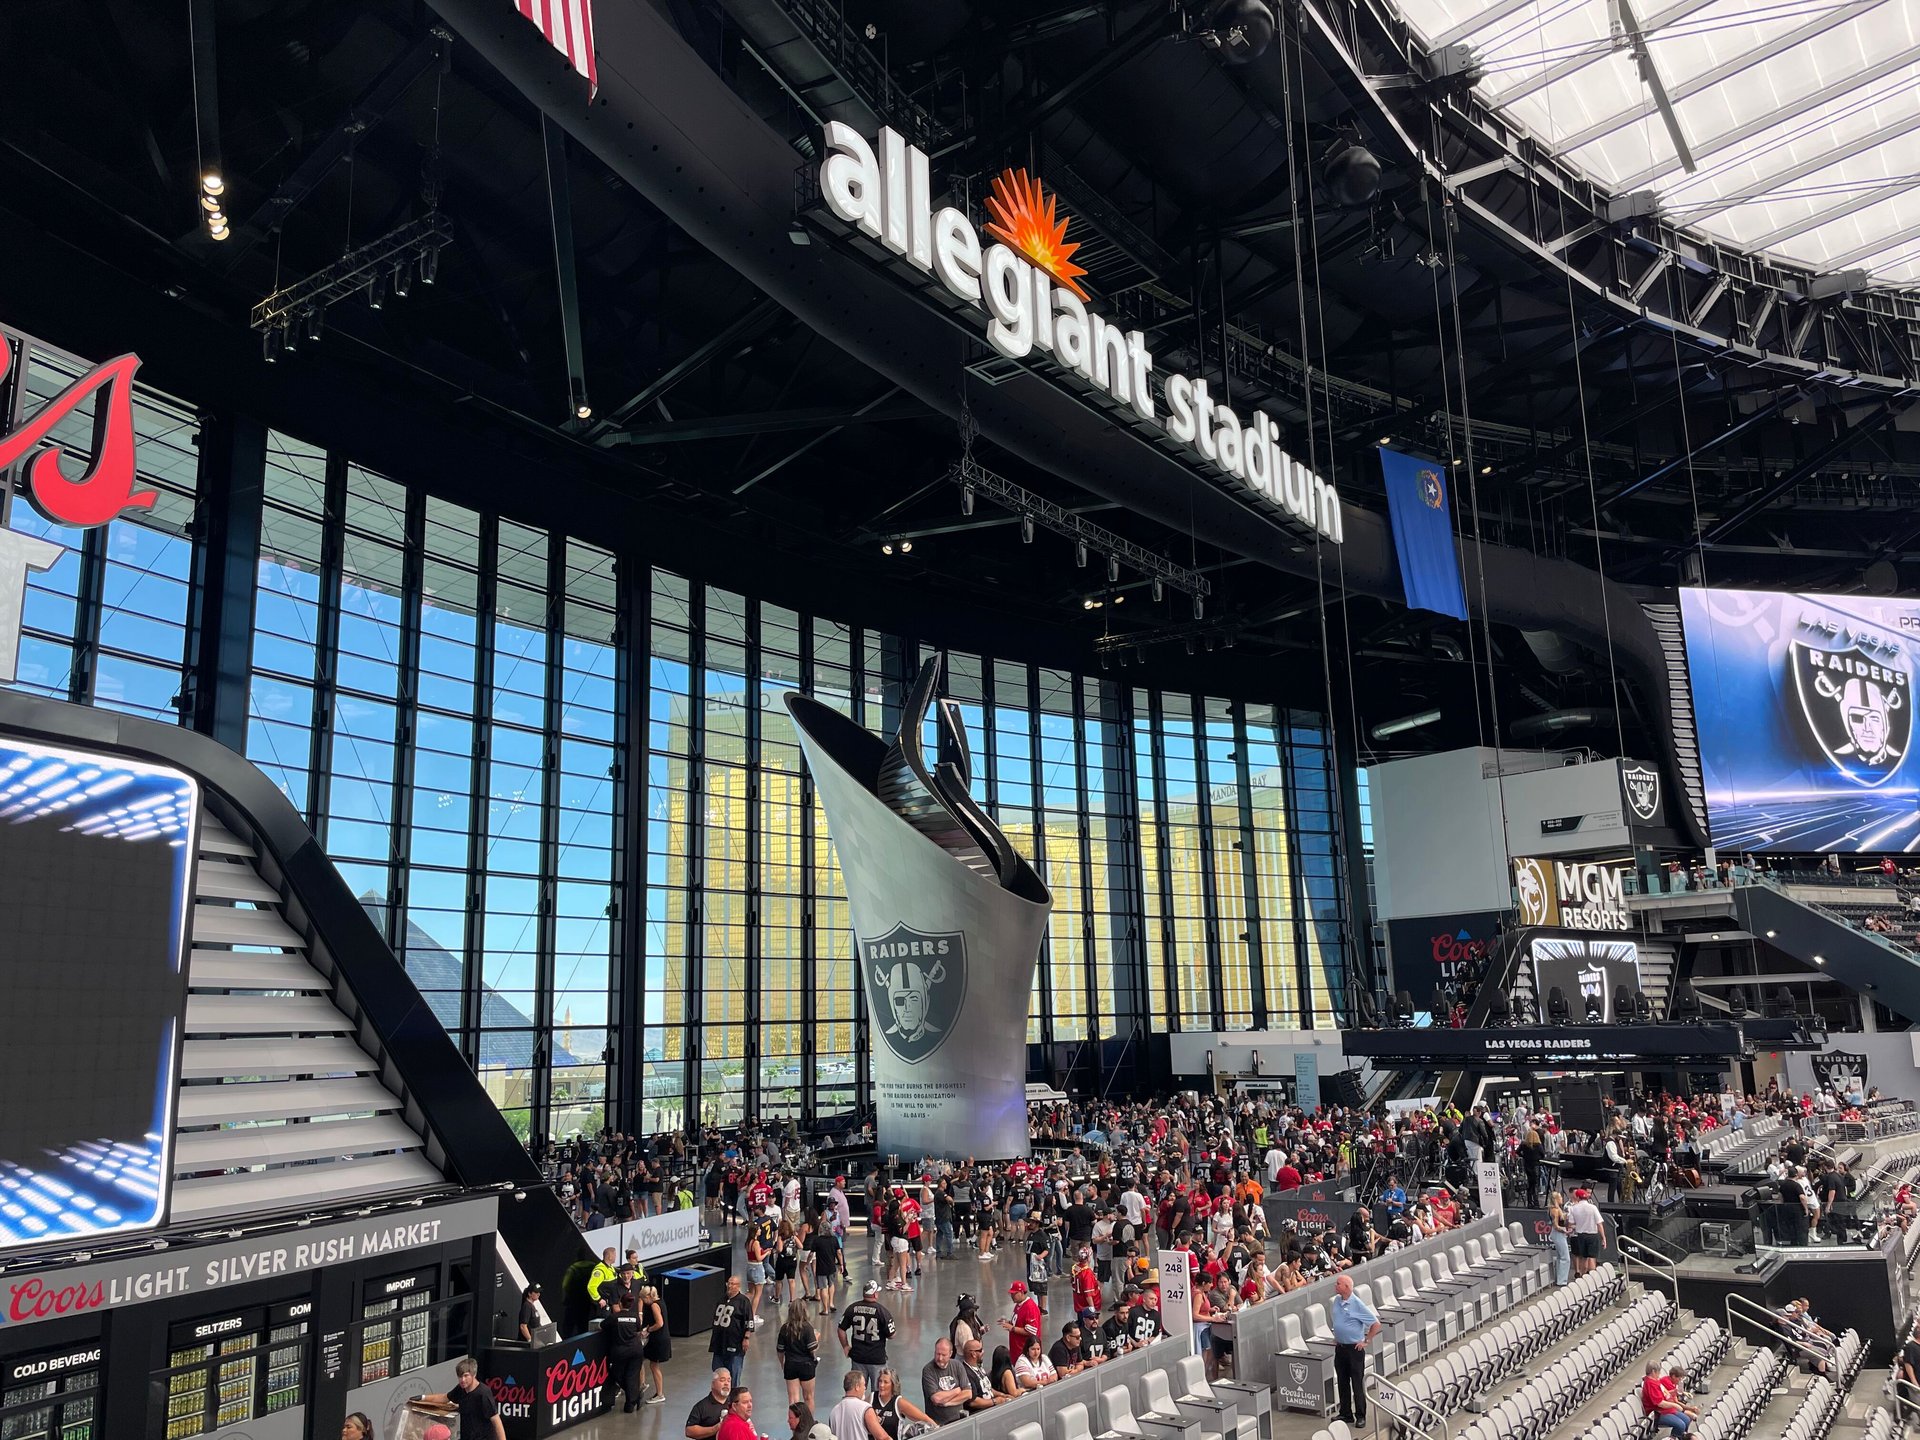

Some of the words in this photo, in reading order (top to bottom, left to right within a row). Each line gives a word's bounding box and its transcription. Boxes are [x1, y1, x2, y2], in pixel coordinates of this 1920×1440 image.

[820, 121, 1155, 418] allegiant
[1166, 373, 1343, 544] stadium
[1809, 648, 1905, 686] RAIDERS
[1627, 773, 1655, 782] RAIDERS
[1209, 784, 1238, 802] MANDA
[1252, 774, 1268, 790] BAY
[1556, 861, 1625, 905] MGM
[1563, 906, 1628, 931] RESORTS
[869, 939, 950, 959] RAIDERS
[1485, 1039, 1506, 1049] LAS
[1507, 1039, 1542, 1049] VEGAS
[1544, 1038, 1591, 1049] RAIDERS
[1816, 1055, 1862, 1063] RAIDERS
[1121, 1165, 1133, 1179] 32
[1238, 1160, 1251, 1172] 24
[755, 1193, 766, 1204] 23
[1484, 1186, 1497, 1194] 248
[1297, 1207, 1329, 1222] Coors
[641, 1228, 671, 1249] Coors
[670, 1225, 694, 1243] LIGHT
[765, 1221, 772, 1240] 2
[206, 1248, 287, 1286] SILVER
[295, 1236, 354, 1268] RUSH
[361, 1220, 441, 1255] MARKET
[1165, 1263, 1182, 1273] 248
[1235, 1260, 1242, 1272] 4
[9, 1278, 105, 1321] Coors
[109, 1266, 190, 1304] LIGHT
[386, 1277, 416, 1293] IMPORT
[1167, 1290, 1184, 1299] 247
[290, 1302, 311, 1317] DOM
[713, 1304, 734, 1328] 98
[195, 1318, 243, 1337] SELTZERS
[852, 1315, 880, 1342] 24
[1135, 1317, 1155, 1341] 28
[1089, 1344, 1103, 1358] 17
[14, 1361, 47, 1379] COLD
[546, 1355, 610, 1404] Coors
[485, 1376, 536, 1405] Coors
[1280, 1386, 1301, 1397] Coors
[1301, 1392, 1321, 1401] LIGHT
[1379, 1392, 1394, 1400] 247
[497, 1402, 531, 1418] IGHT
[552, 1386, 603, 1426] LIGHT
[1286, 1396, 1316, 1407] LANDING
